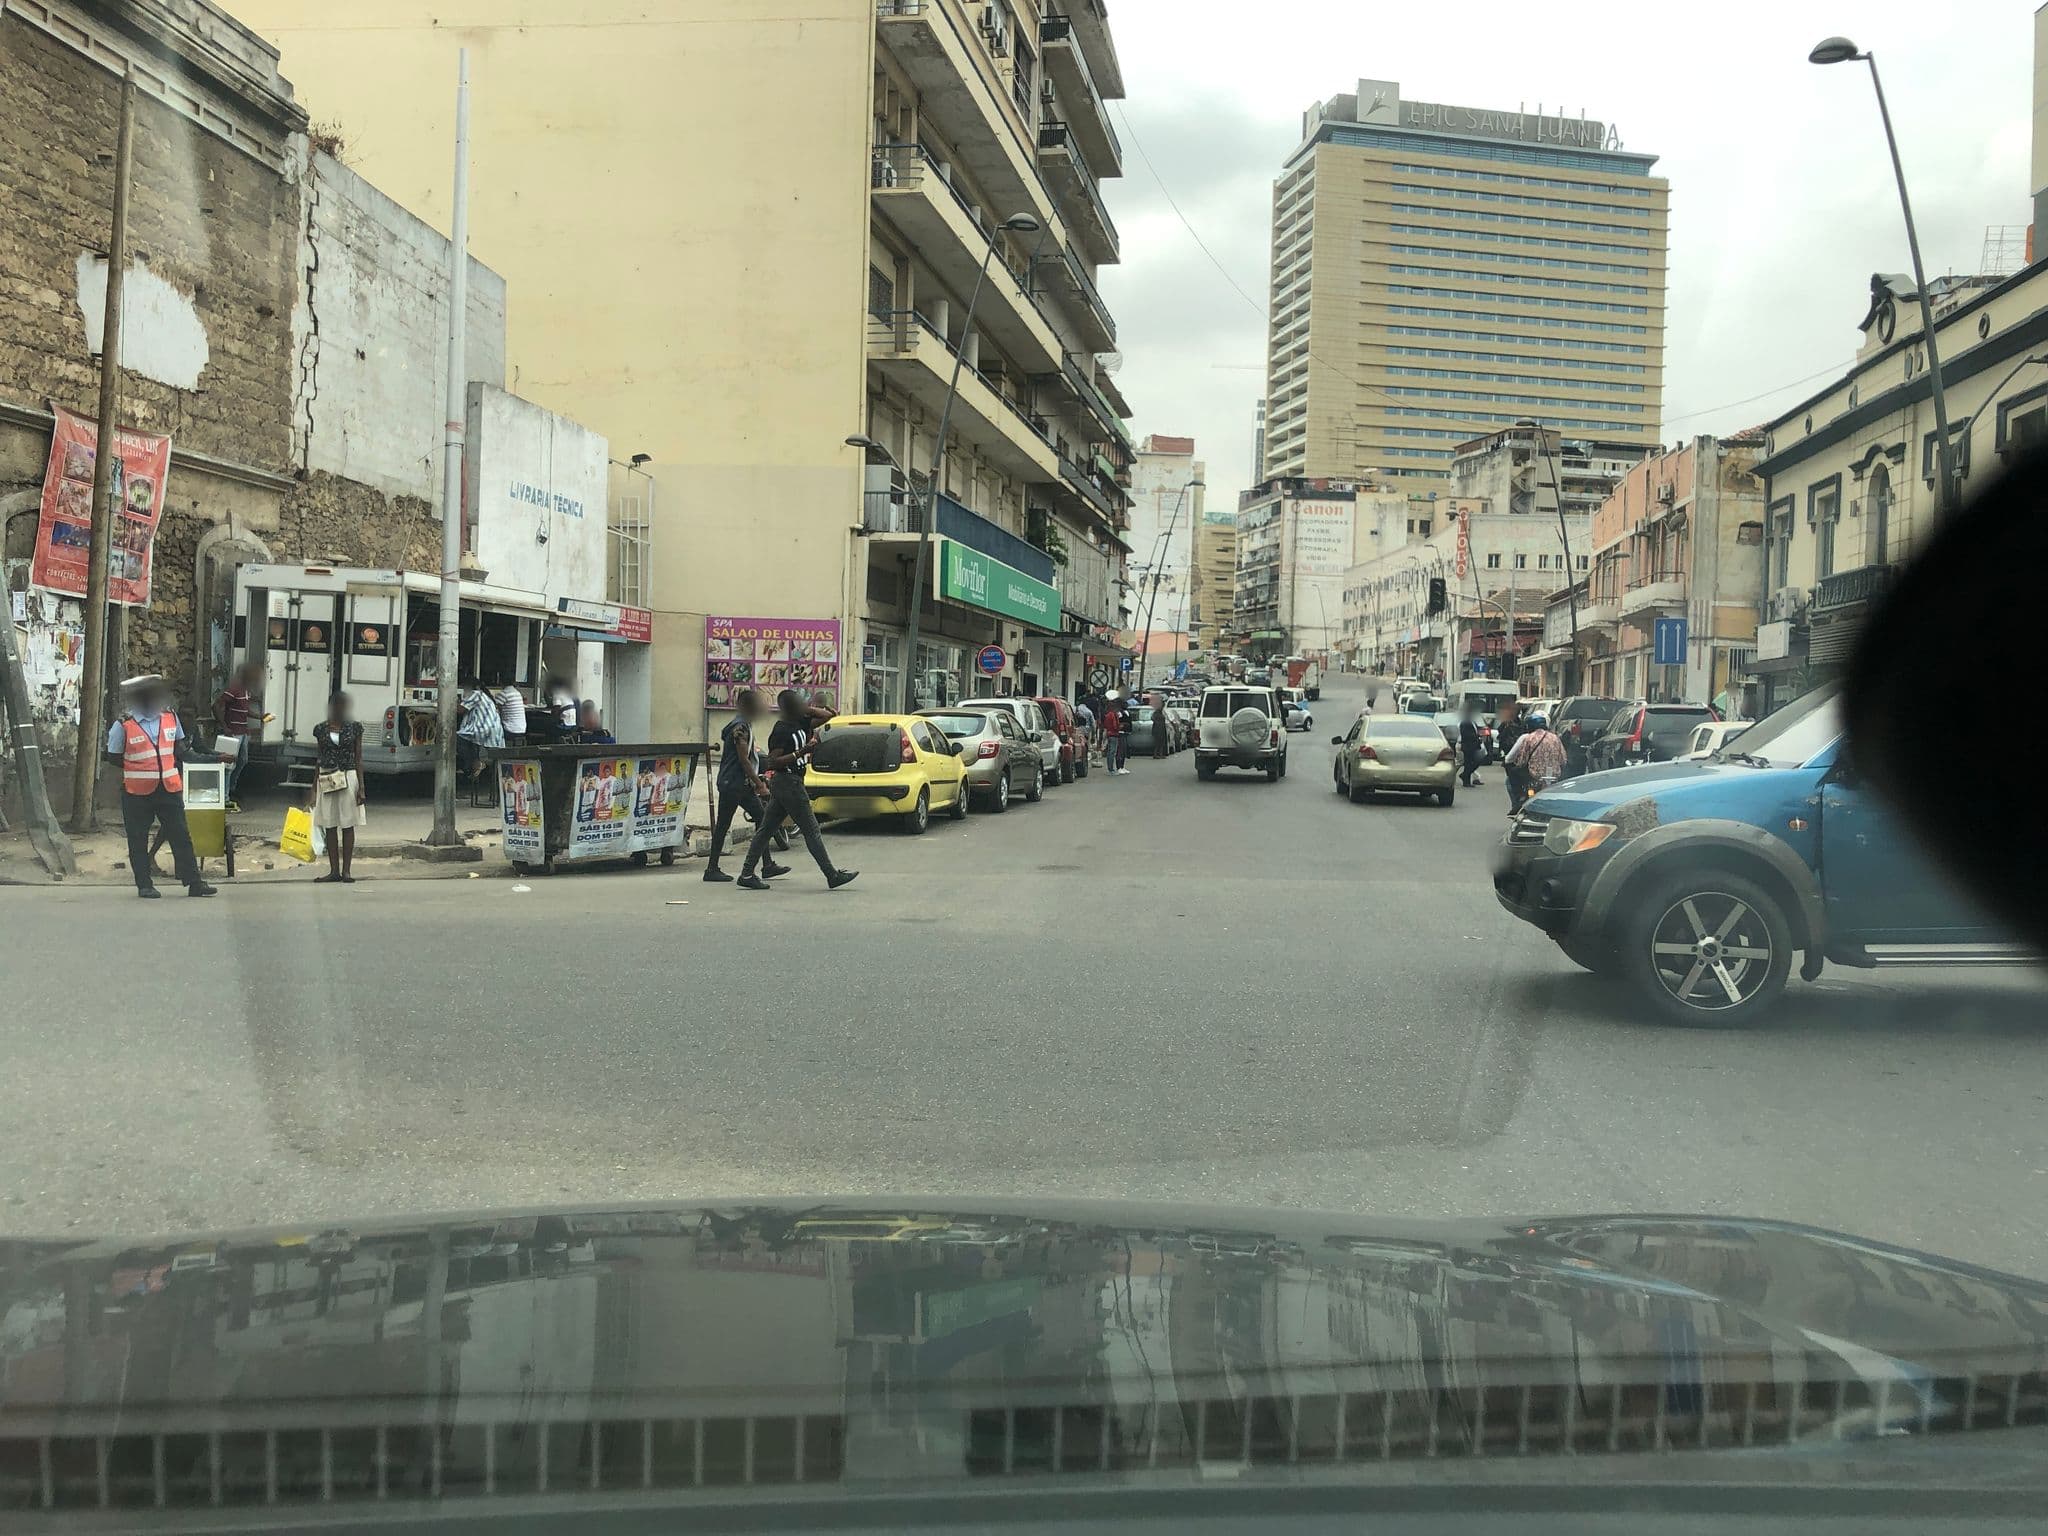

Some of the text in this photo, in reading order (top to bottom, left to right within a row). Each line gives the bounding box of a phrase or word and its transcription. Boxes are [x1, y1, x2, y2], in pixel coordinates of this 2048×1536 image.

[1409, 102, 1620, 145] EPIC SANA LUANDA
[509, 480, 584, 519] LIVRARIA TÉCNICA
[1291, 502, 1344, 516] Canon
[953, 555, 986, 594] Moviflor
[712, 619, 733, 627] SPA
[712, 628, 834, 640] SALAO DE UNHAS
[1122, 658, 1131, 669] P
[579, 822, 600, 832] SÁB
[636, 818, 655, 827] SÁB
[577, 833, 600, 841] DOM
[634, 828, 655, 836] DOM
[508, 838, 523, 846] DOM
